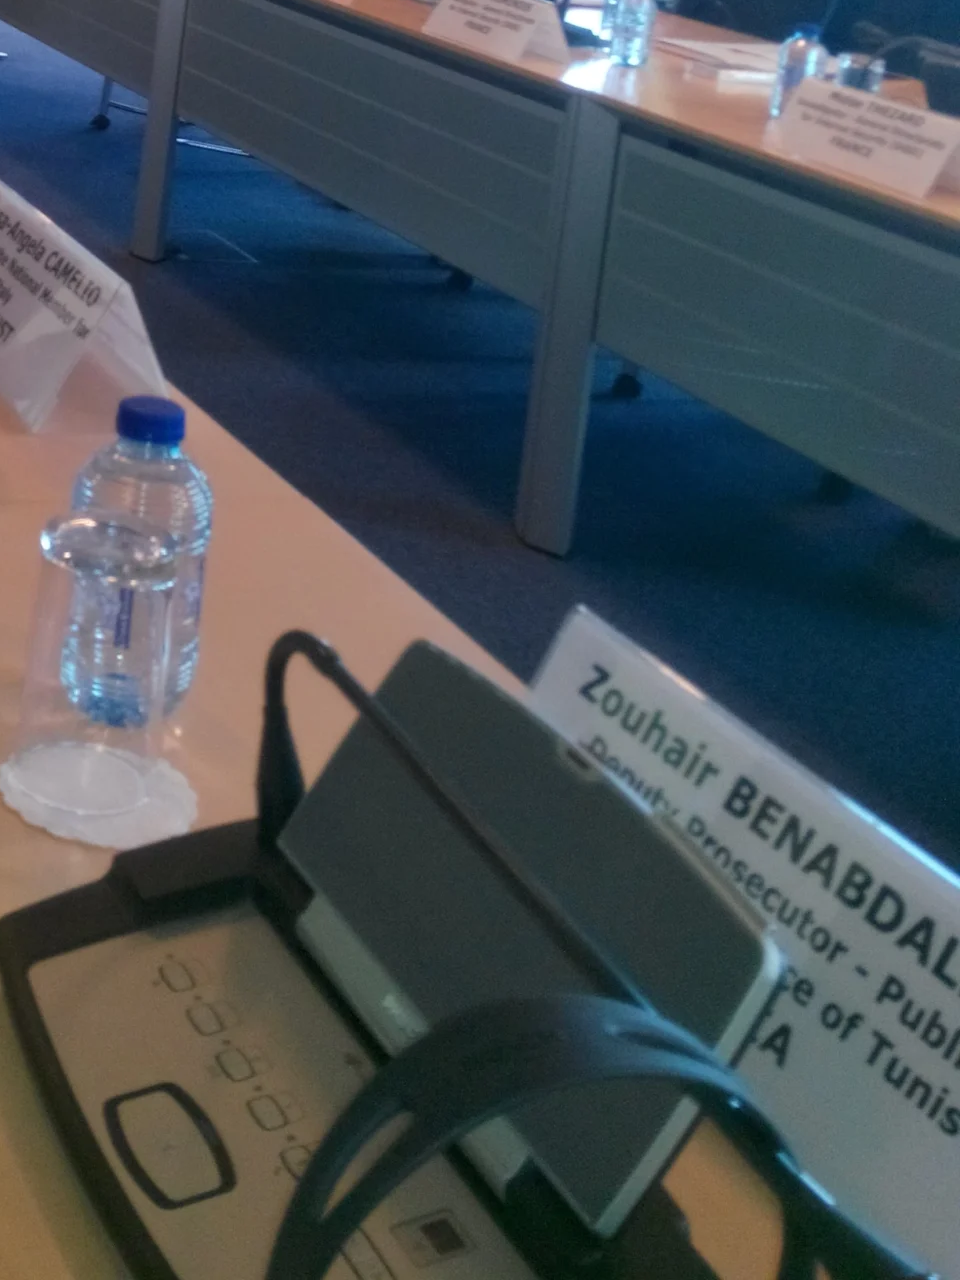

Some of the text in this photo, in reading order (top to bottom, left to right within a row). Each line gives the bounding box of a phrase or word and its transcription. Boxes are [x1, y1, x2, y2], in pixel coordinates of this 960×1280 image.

[44, 251, 101, 307] CAMELIO
[578, 663, 721, 787] Zouhair
[820, 1002, 865, 1042] of
